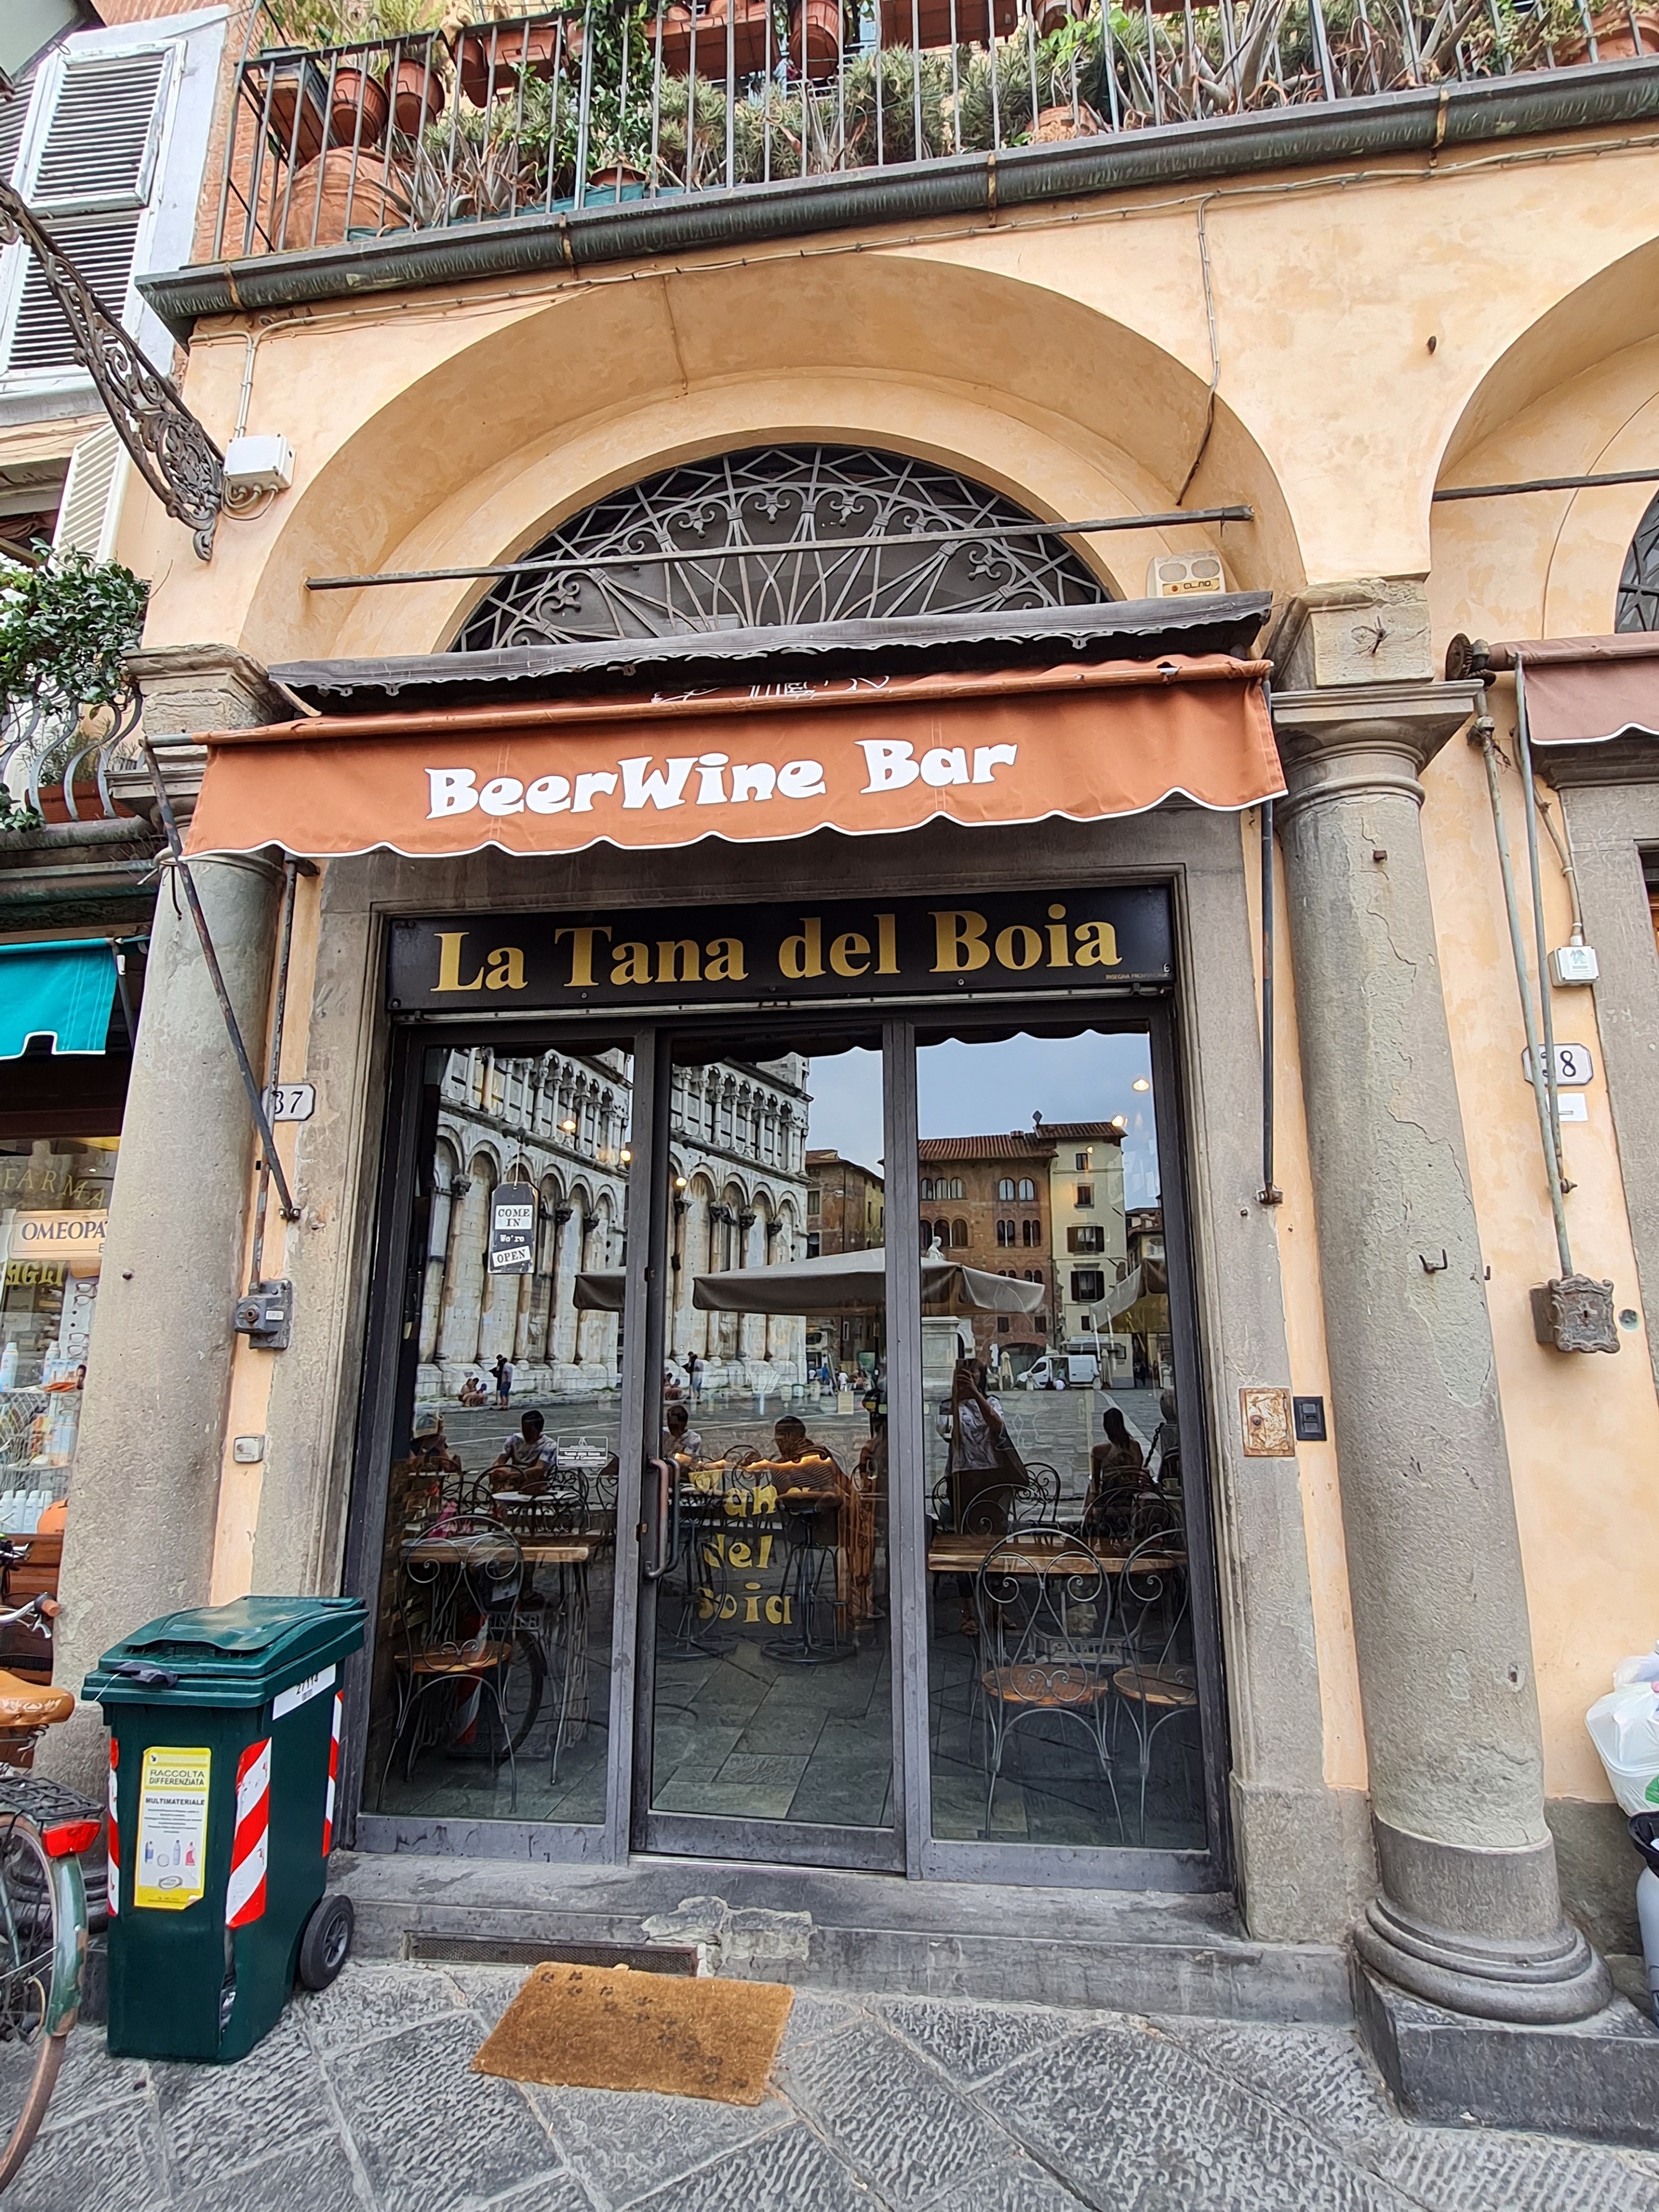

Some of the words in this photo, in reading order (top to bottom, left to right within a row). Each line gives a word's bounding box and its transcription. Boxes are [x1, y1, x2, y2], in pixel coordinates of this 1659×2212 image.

[854, 739, 1017, 794] Bar
[431, 931, 527, 992] La
[554, 926, 748, 987] Tana
[779, 914, 902, 980] del
[928, 903, 1122, 973] Boia
[275, 1091, 303, 1115] 37
[4, 1168, 105, 1209] FARMA
[498, 1208, 530, 1218] COME
[506, 1218, 521, 1227] IN
[22, 1221, 108, 1240] OMEOPA
[497, 1249, 526, 1263] OPEN
[704, 1533, 772, 1569] del
[149, 1777, 204, 1785] DIFFERENZIATA
[150, 1769, 205, 1778] RACCOLTA
